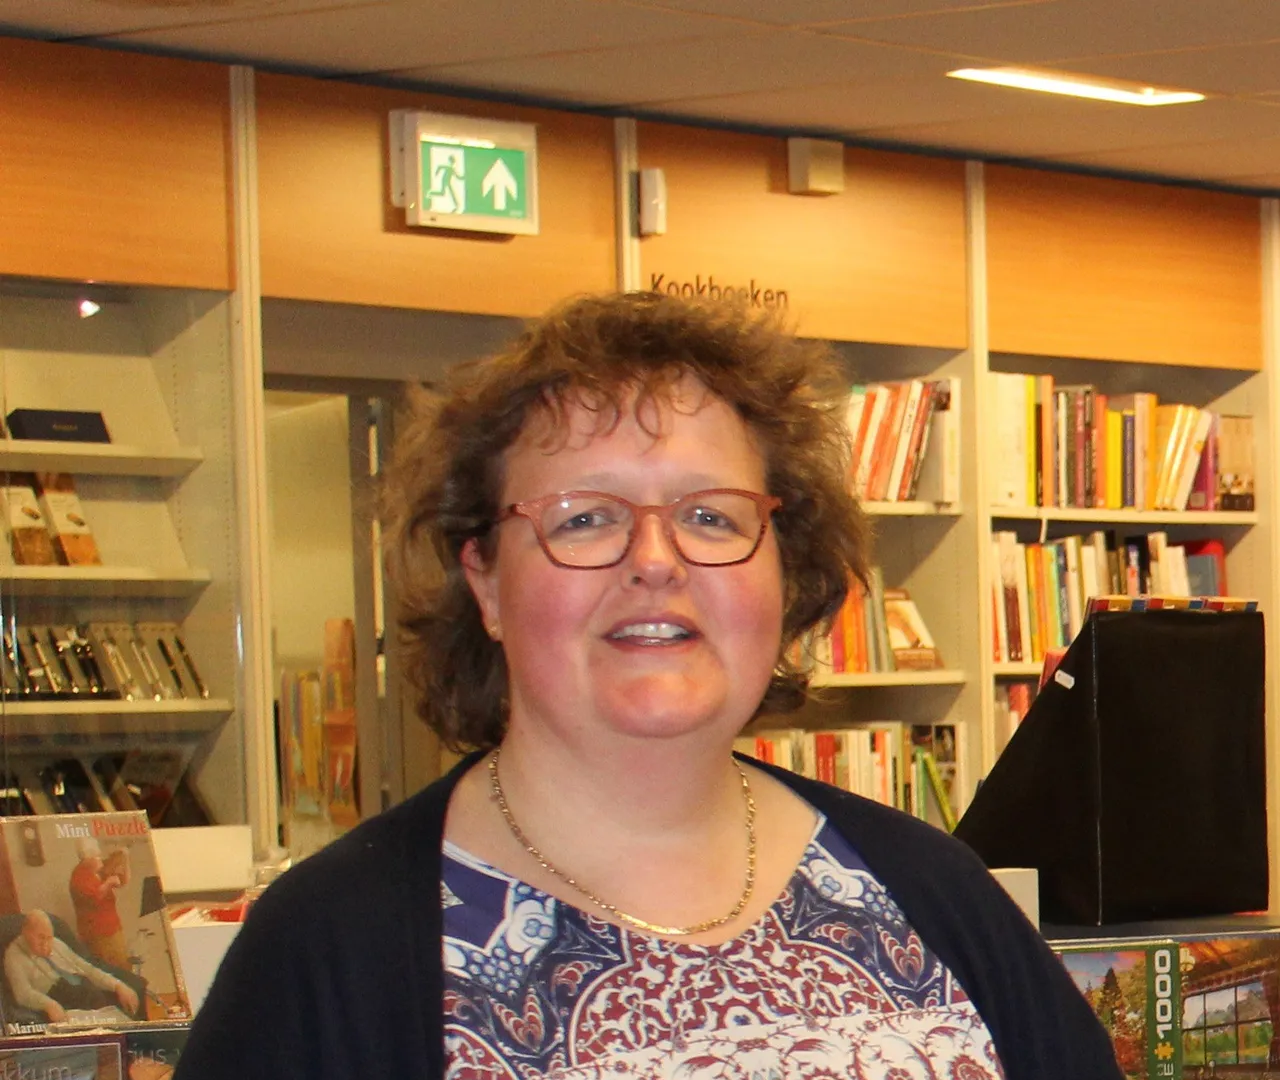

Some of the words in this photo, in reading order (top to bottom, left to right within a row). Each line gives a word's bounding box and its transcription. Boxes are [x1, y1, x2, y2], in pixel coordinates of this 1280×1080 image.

[55, 823, 91, 839] Mini
[91, 816, 148, 838] Puzzle
[1154, 949, 1172, 1039] 1000
